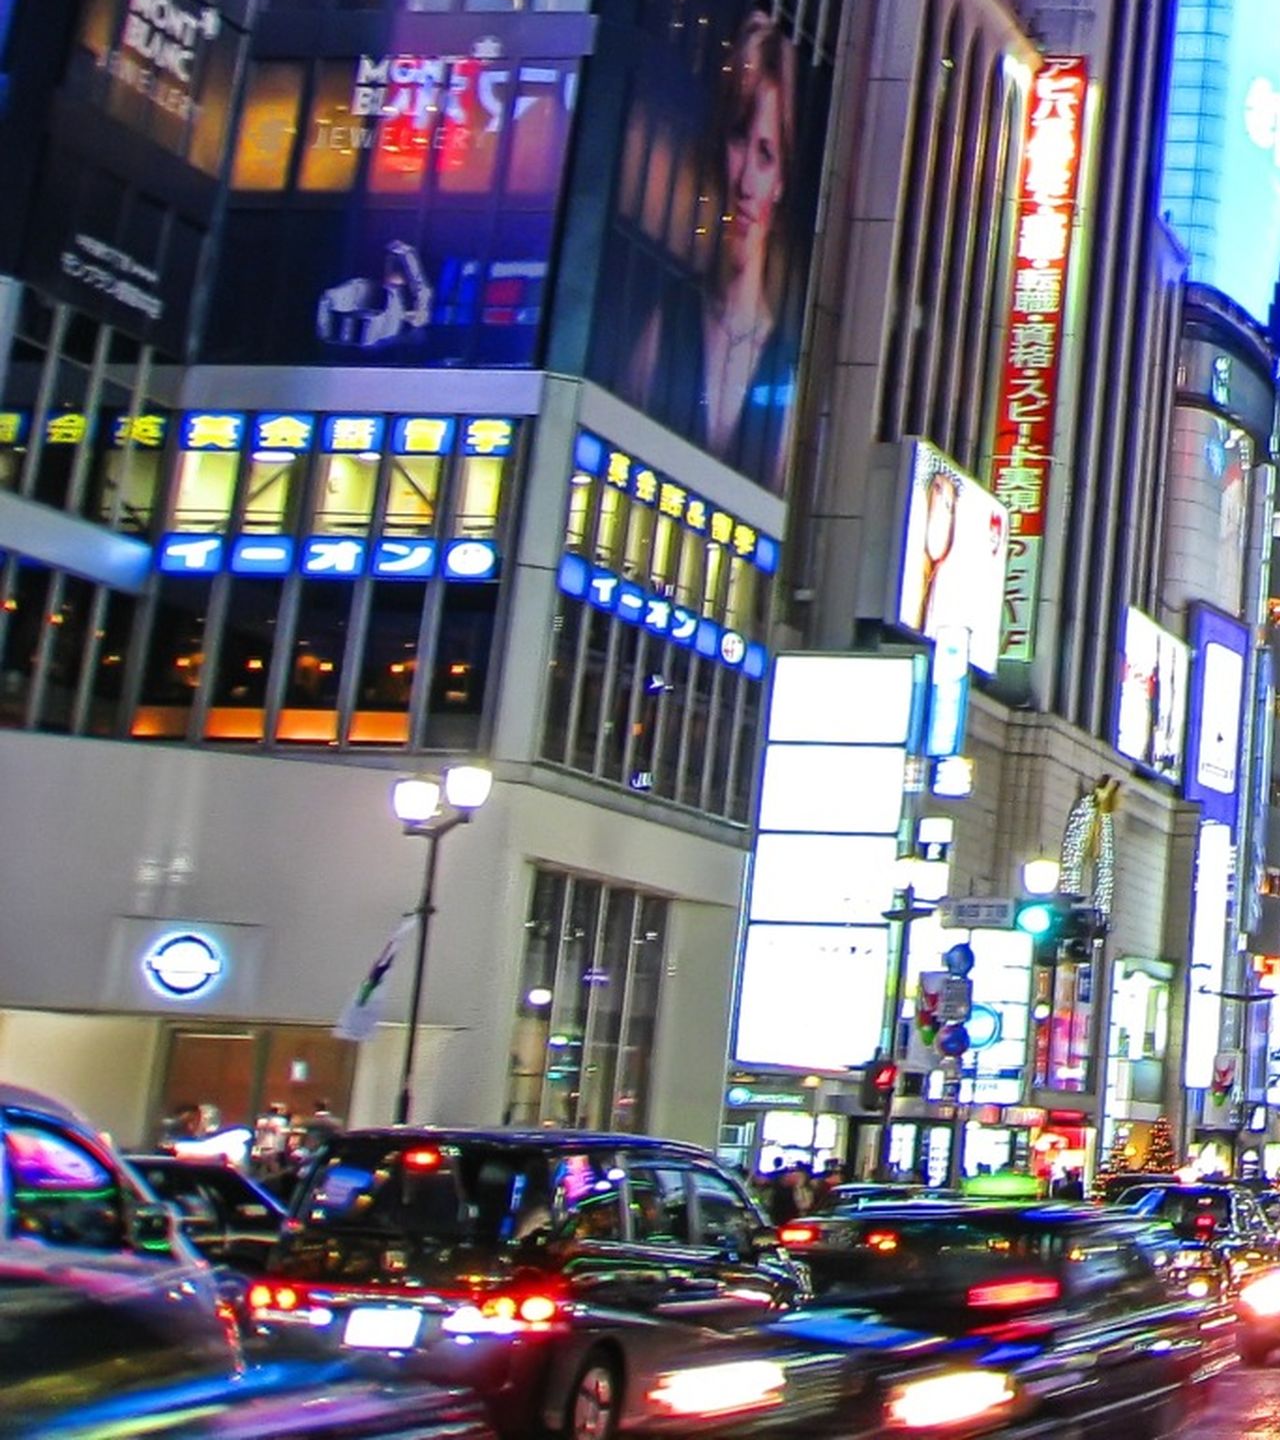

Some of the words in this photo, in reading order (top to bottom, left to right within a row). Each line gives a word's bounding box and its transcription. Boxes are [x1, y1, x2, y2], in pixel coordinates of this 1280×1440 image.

[165, 538, 432, 574] イーオン
[591, 577, 697, 639] イーオン
